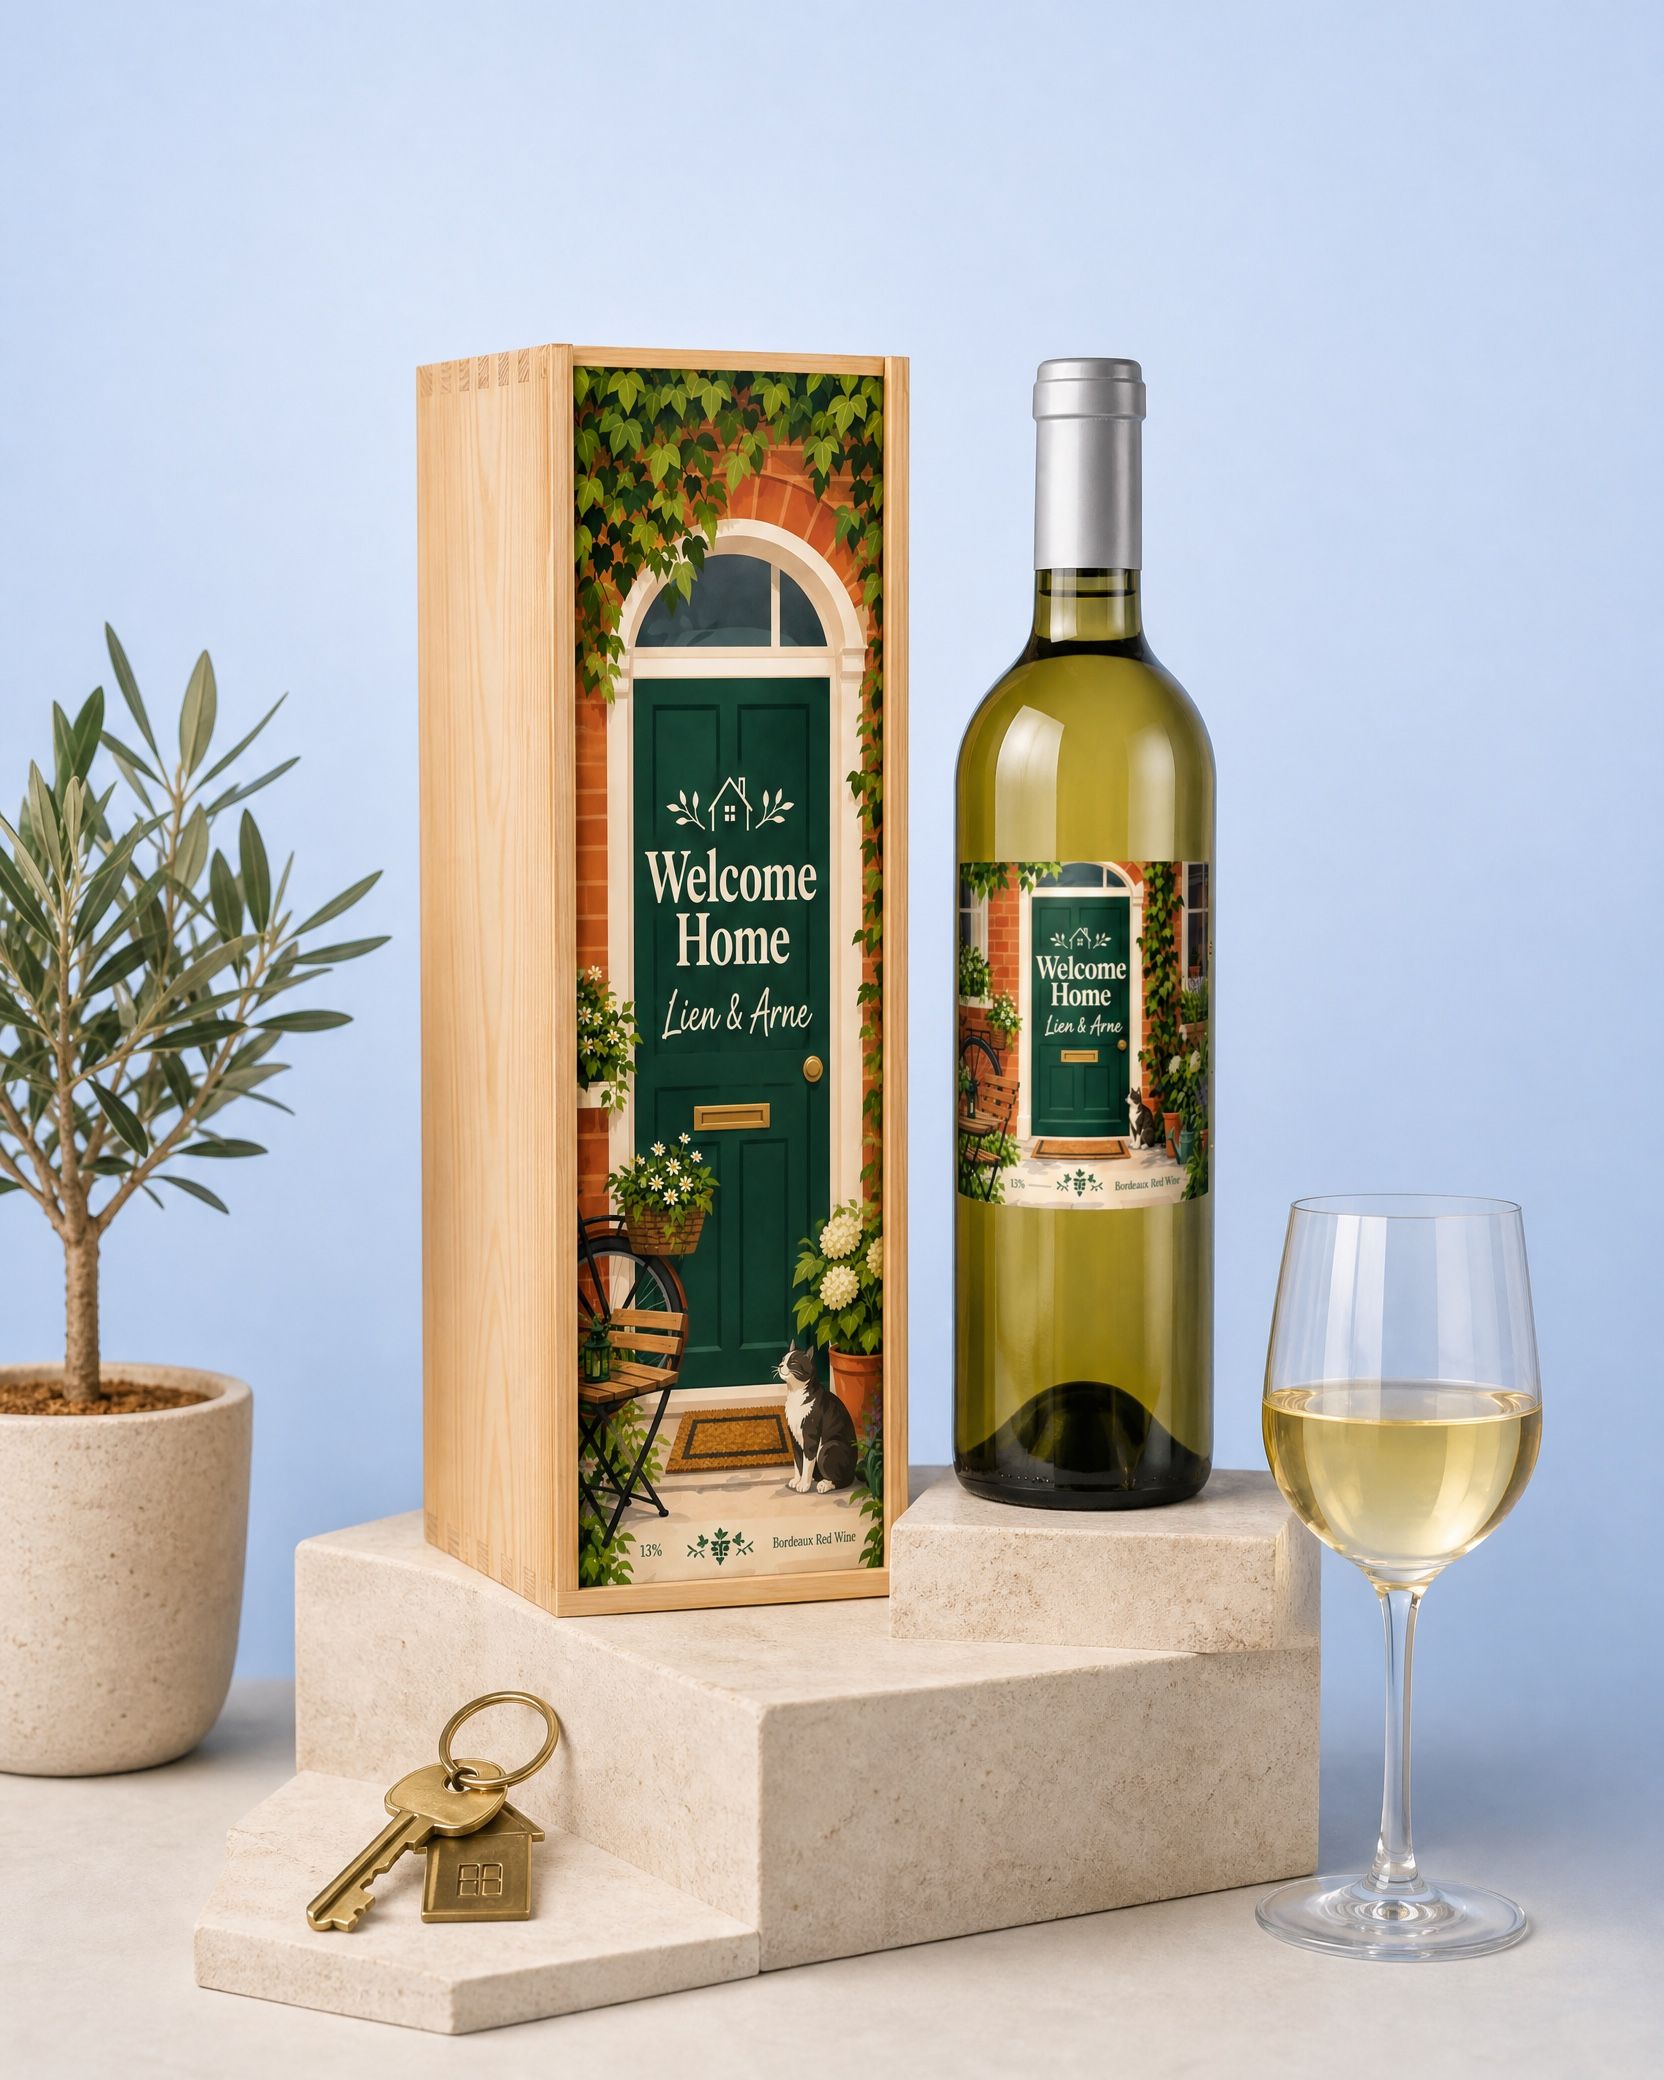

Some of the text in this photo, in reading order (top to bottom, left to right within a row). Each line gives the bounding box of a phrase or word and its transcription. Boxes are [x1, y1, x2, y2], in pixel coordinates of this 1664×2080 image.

[644, 847, 818, 904] Welcome
[676, 912, 790, 967] Home
[1035, 955, 1127, 980] Welcome
[1050, 982, 1112, 1006] Home
[661, 986, 813, 1040] Lien & Arne
[1044, 1014, 1123, 1037] Lien & Arne
[1010, 1178, 1025, 1189] 13%
[1115, 1180, 1149, 1191] Bordeaux
[1150, 1177, 1164, 1188] Red
[640, 1543, 663, 1558] 13%
[772, 1530, 857, 1549] Bordeaux Red Wine
